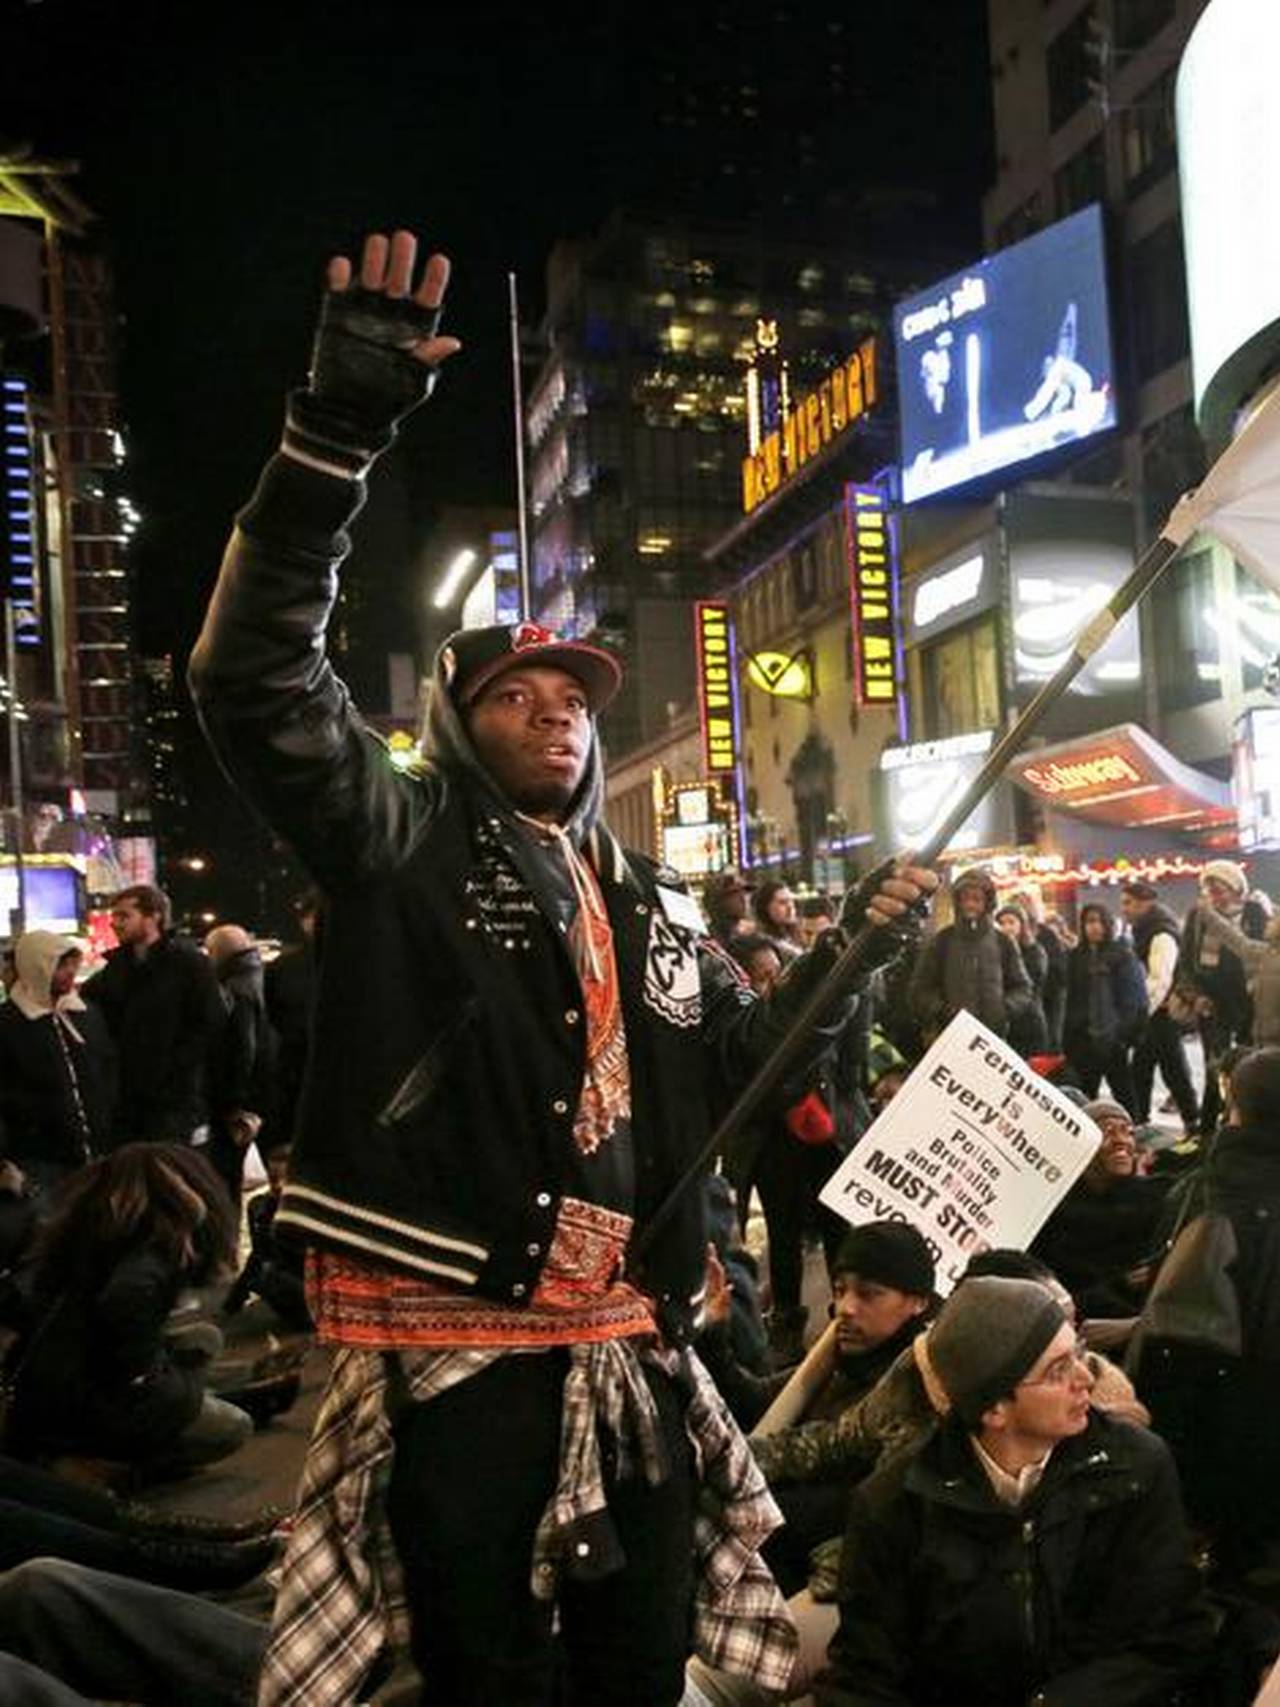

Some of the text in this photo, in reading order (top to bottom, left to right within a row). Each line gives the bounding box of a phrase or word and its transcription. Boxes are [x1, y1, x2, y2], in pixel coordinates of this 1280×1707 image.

[855, 492, 895, 698] NEW VICTORY
[702, 608, 734, 768] NEW VICTORY
[928, 1064, 1065, 1185] Everywhere
[967, 1035, 1082, 1139] Ferguson
[1000, 1092, 1024, 1120] is
[863, 1150, 941, 1210] MUST
[904, 1149, 994, 1230] and Murder
[929, 1137, 998, 1206] Brutality
[950, 1128, 1001, 1181] Police
